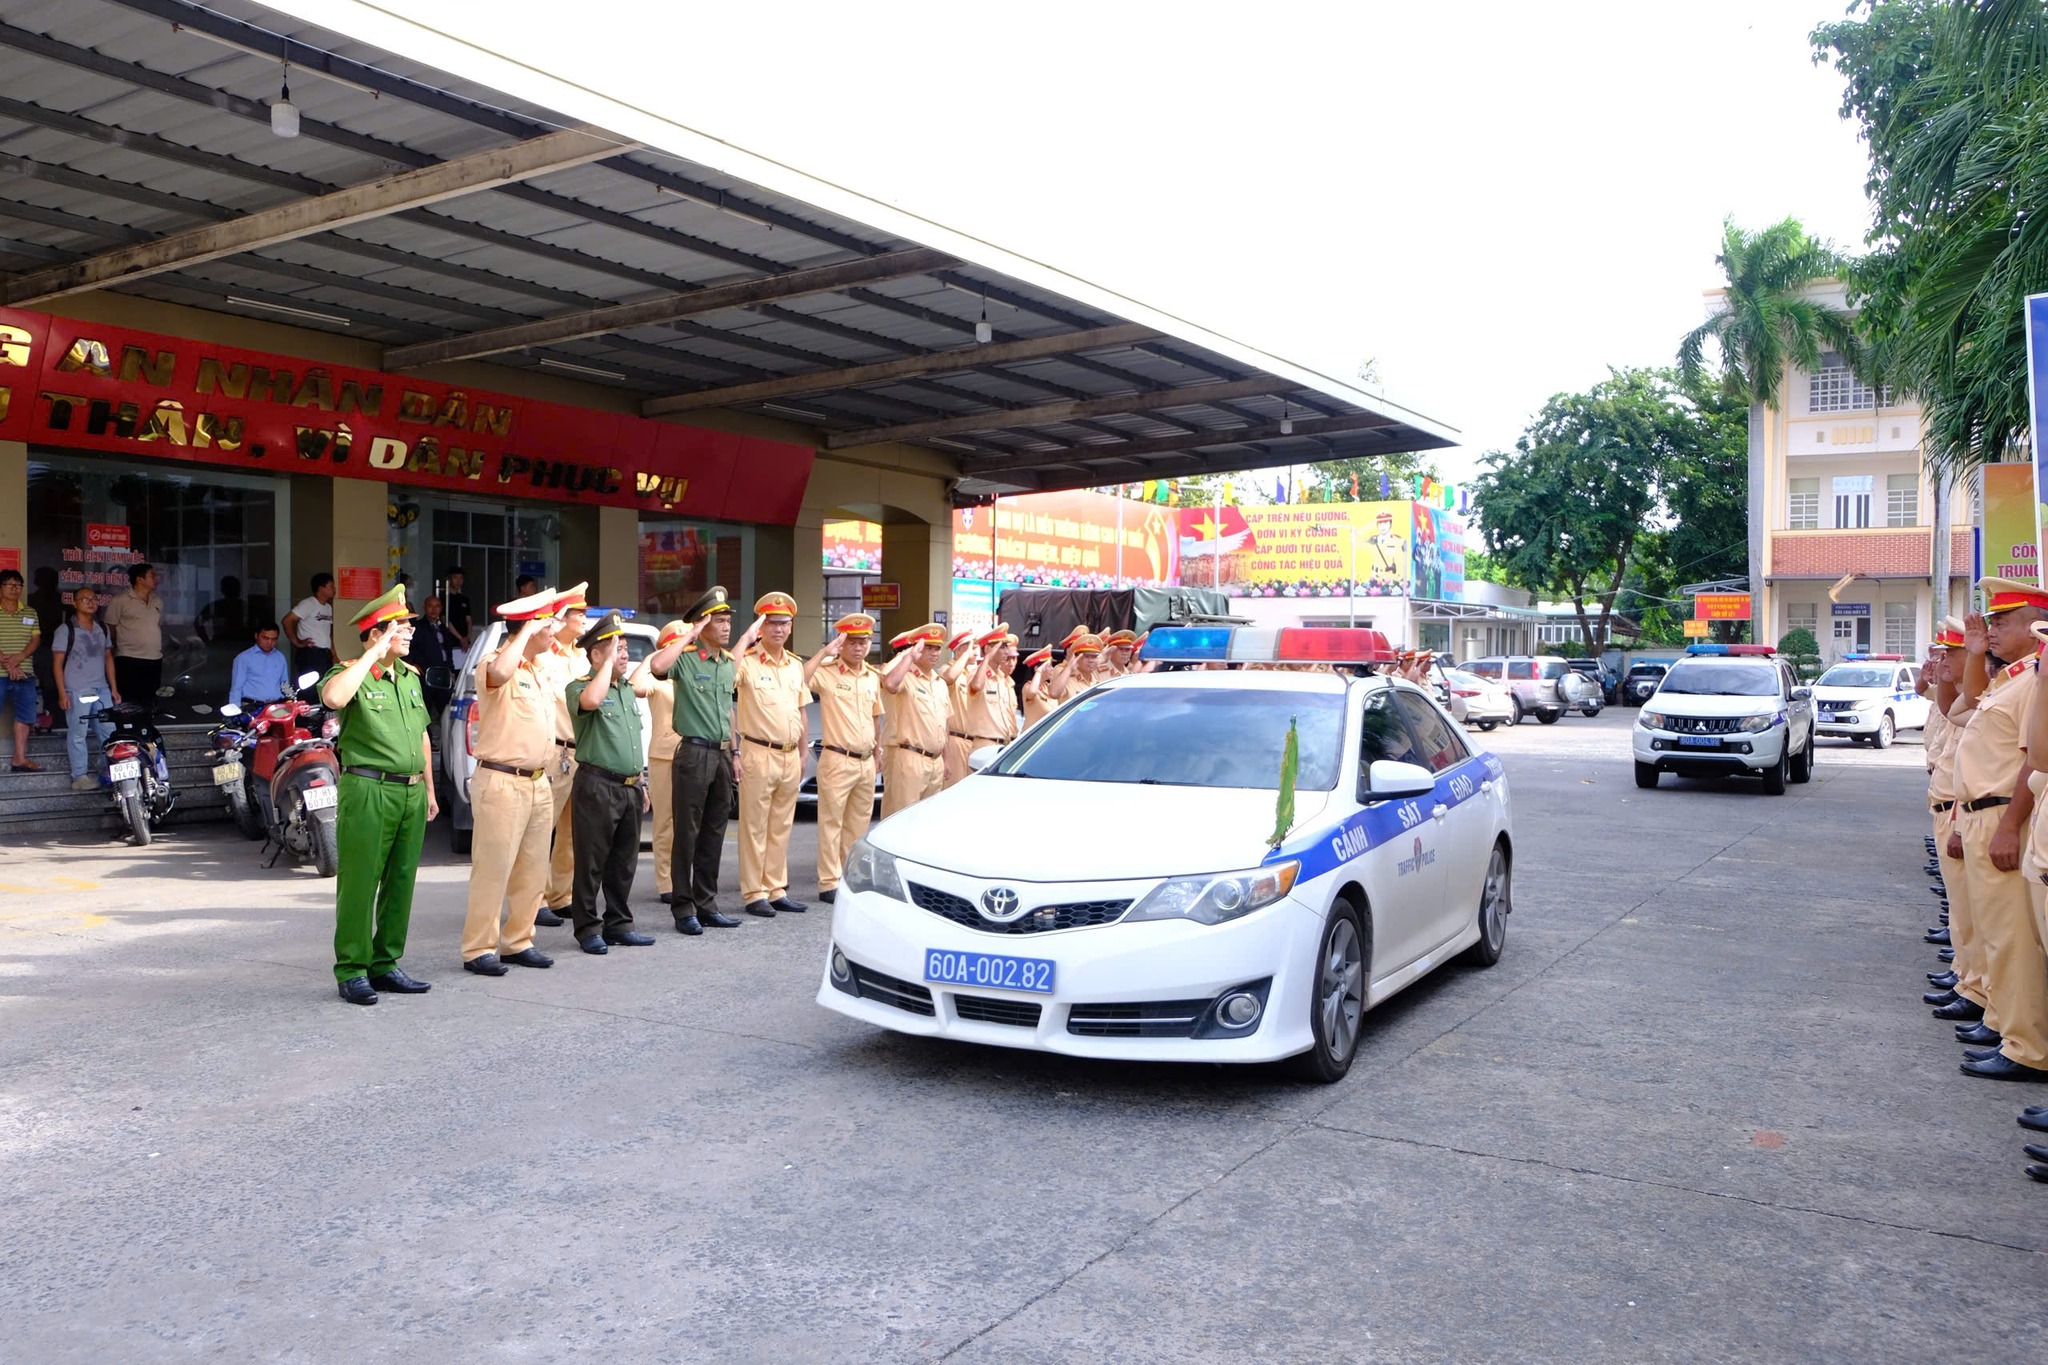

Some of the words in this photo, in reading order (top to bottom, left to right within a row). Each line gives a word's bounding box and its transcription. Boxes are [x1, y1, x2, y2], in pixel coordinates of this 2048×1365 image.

[54, 336, 176, 387] AN
[196, 357, 384, 417] NHÂN
[398, 389, 513, 436] DÂN
[296, 422, 354, 464] VÌ
[368, 435, 487, 480] DÂN
[498, 453, 624, 498] PHỤC
[635, 470, 689, 510] VỤ
[1251, 558, 1276, 570] CÔNG
[1299, 557, 1321, 571] HIỆU
[1324, 556, 1343, 570] QUẢ
[935, 612, 947, 623] WC
[1331, 824, 1369, 862] CẢNH
[1397, 800, 1423, 829] SÁT
[1449, 774, 1474, 801] GIAO
[1397, 857, 1415, 877] TRAFFIC
[1421, 848, 1436, 869] POLICE
[929, 953, 1050, 989] 60A-002.82
